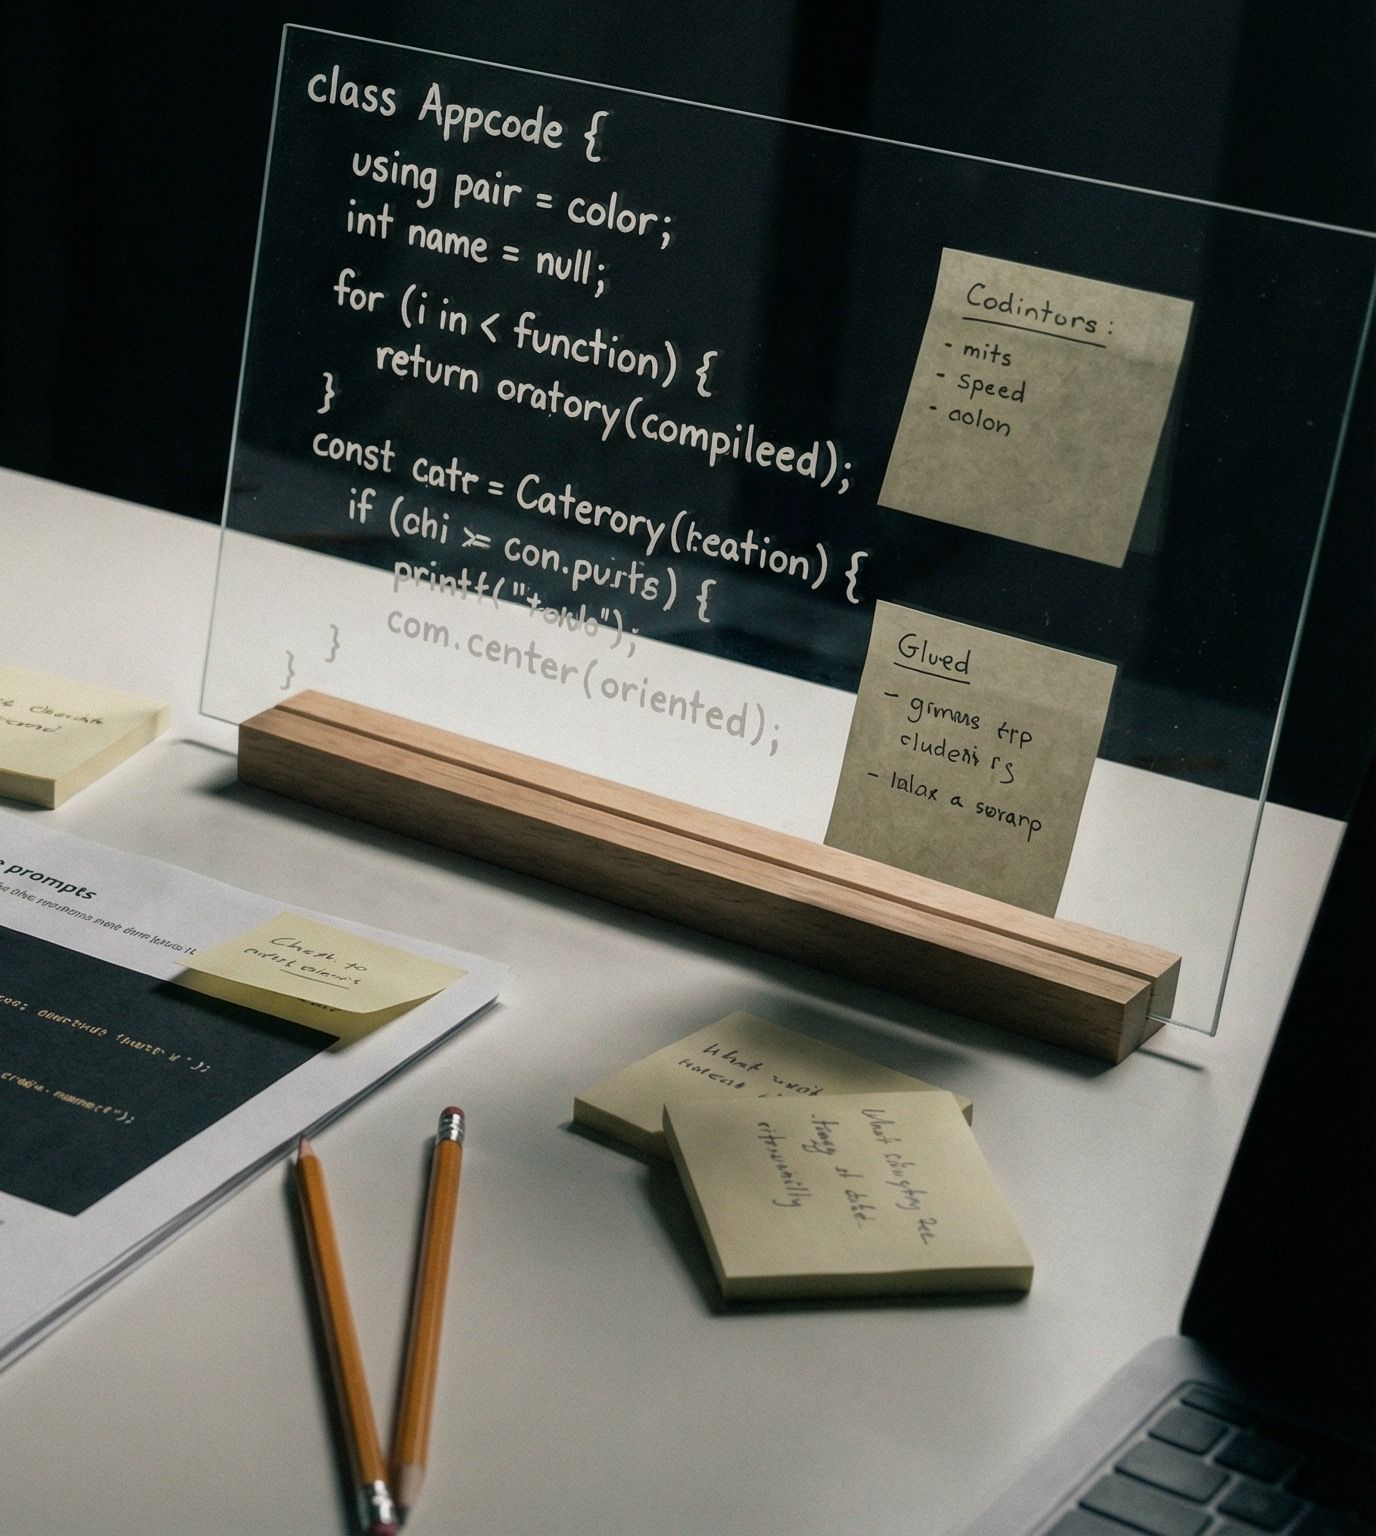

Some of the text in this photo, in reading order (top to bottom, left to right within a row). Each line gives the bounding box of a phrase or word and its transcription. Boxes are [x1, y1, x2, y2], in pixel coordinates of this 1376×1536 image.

[307, 65, 609, 161] class Appcode {
[352, 150, 674, 250] using pair = color;
[346, 199, 606, 298] int name = null;
[334, 268, 385, 312] for
[439, 298, 468, 336] in
[480, 312, 501, 343] <
[513, 311, 677, 388] function)
[376, 344, 479, 394] return
[963, 343, 1012, 367] mits
[312, 433, 396, 473] const
[349, 488, 377, 524] if
[898, 633, 971, 675] Glued
[4, 864, 97, 900] prompts
